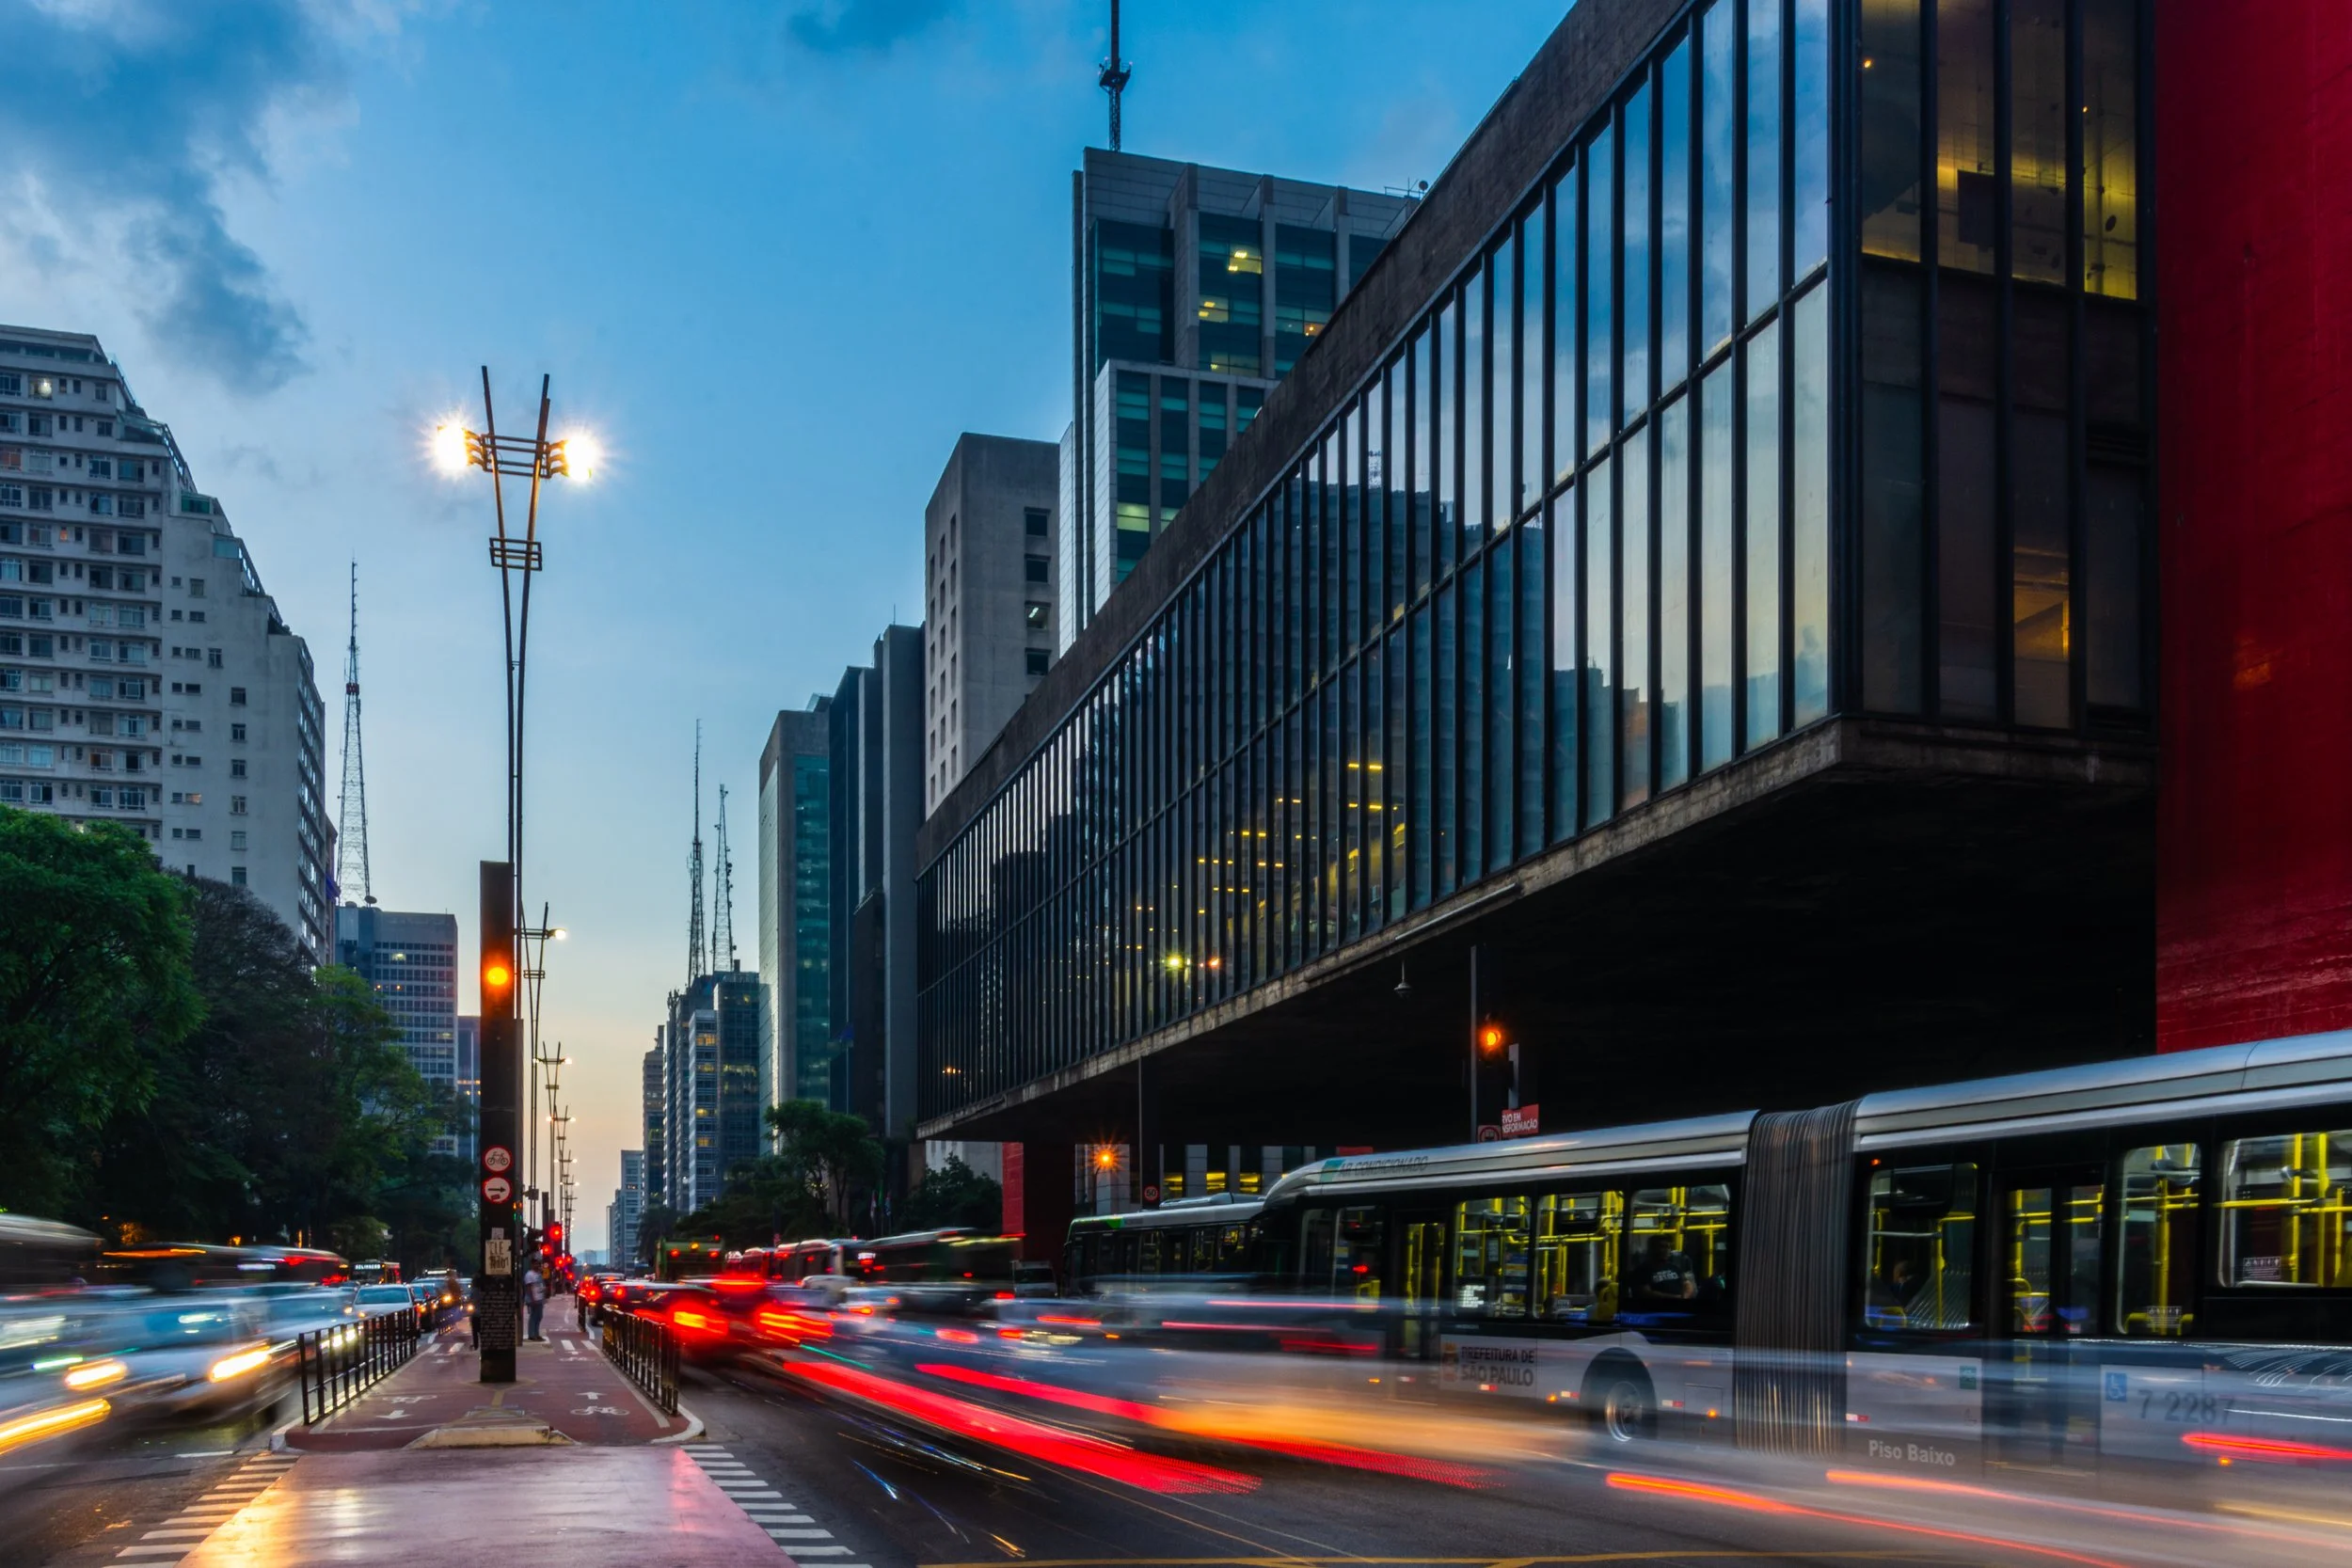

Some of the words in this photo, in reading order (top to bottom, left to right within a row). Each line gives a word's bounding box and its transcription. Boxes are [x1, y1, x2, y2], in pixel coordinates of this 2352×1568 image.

[1355, 1155, 1429, 1176] CONDICIONADO
[1461, 1346, 1518, 1363] PREFEITURA
[1520, 1350, 1535, 1364] DE
[1461, 1360, 1486, 1383] SÃO
[1489, 1365, 1534, 1386] PAULO
[2137, 1388, 2153, 1419] 7
[2165, 1390, 2236, 1426] 2287
[1868, 1439, 1902, 1460] Piso
[1907, 1443, 1956, 1466] Baixo
